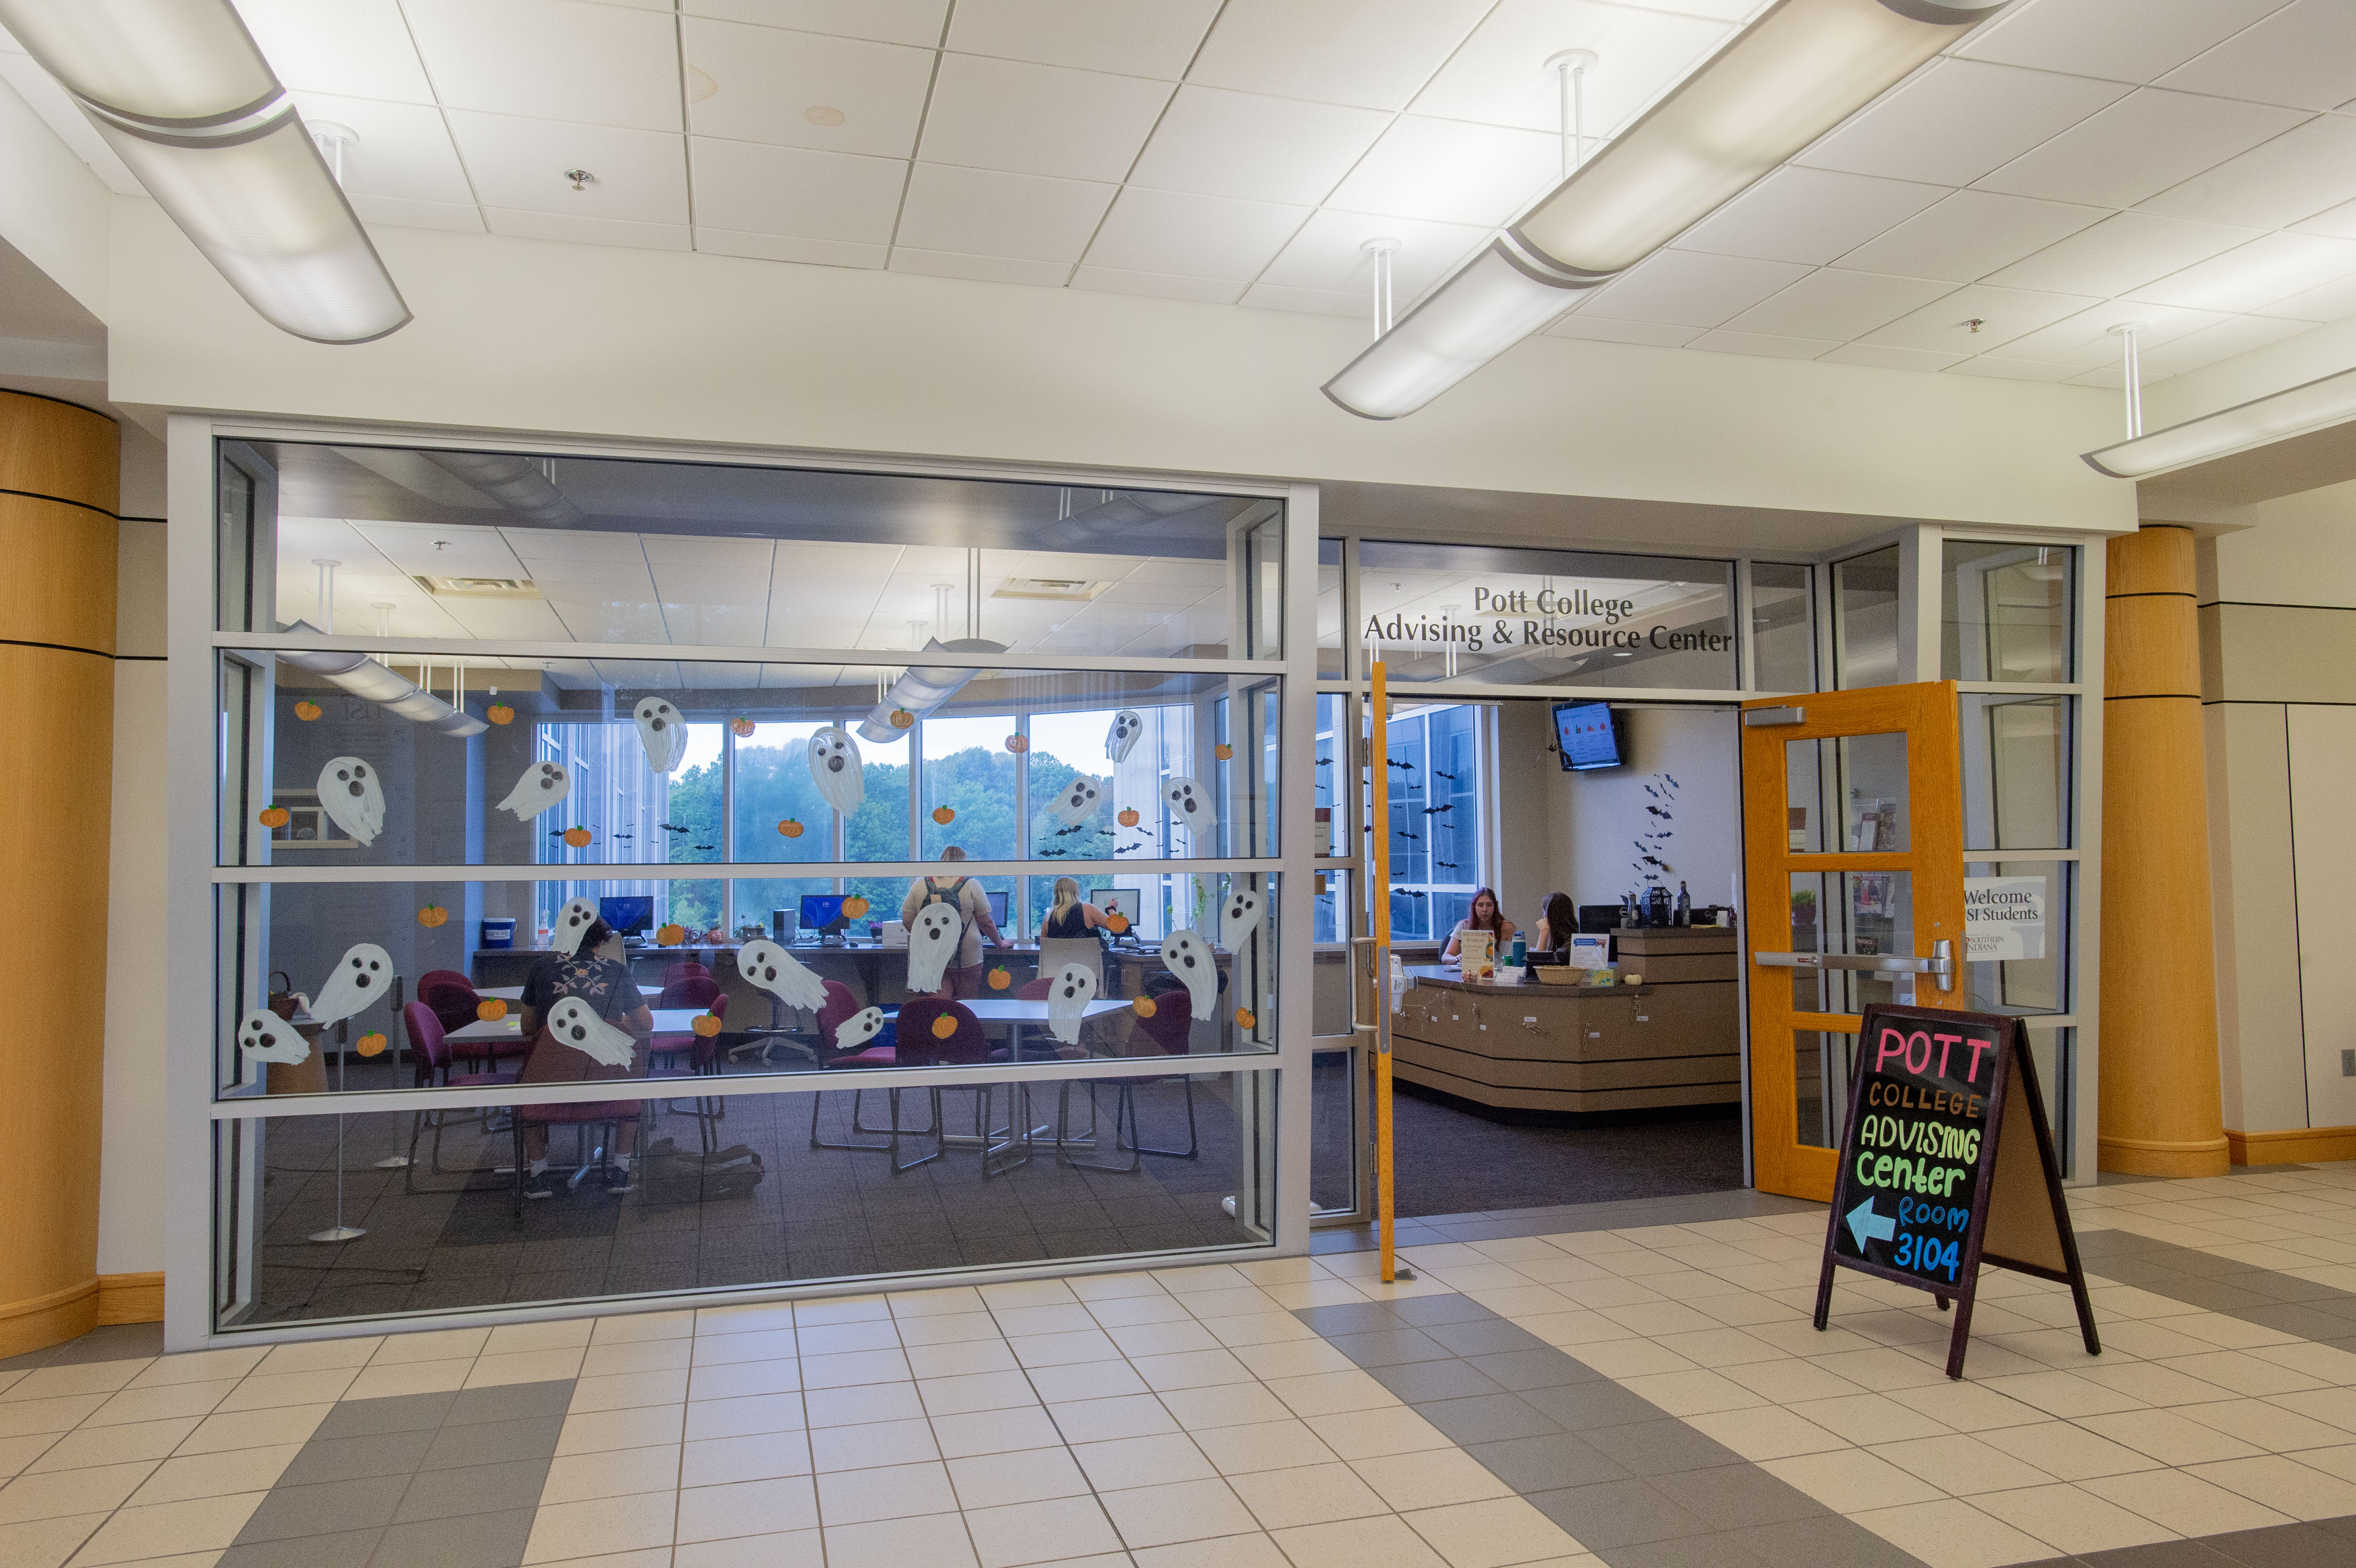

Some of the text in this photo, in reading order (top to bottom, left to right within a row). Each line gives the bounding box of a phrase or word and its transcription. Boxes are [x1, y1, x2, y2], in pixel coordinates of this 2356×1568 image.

[1474, 586, 1634, 625] Pott College
[1364, 613, 1733, 652] Advising & Resource Center
[1964, 889, 2032, 904] Welcome
[1965, 906, 2038, 921] SI Students
[1875, 1028, 1991, 1083] POTT
[1869, 1081, 1982, 1119] COLLEGE
[1861, 1114, 1981, 1165] ADVISING
[1857, 1151, 1966, 1198] Center
[1899, 1196, 1969, 1233] ROOM
[1894, 1232, 1960, 1282] 3104
